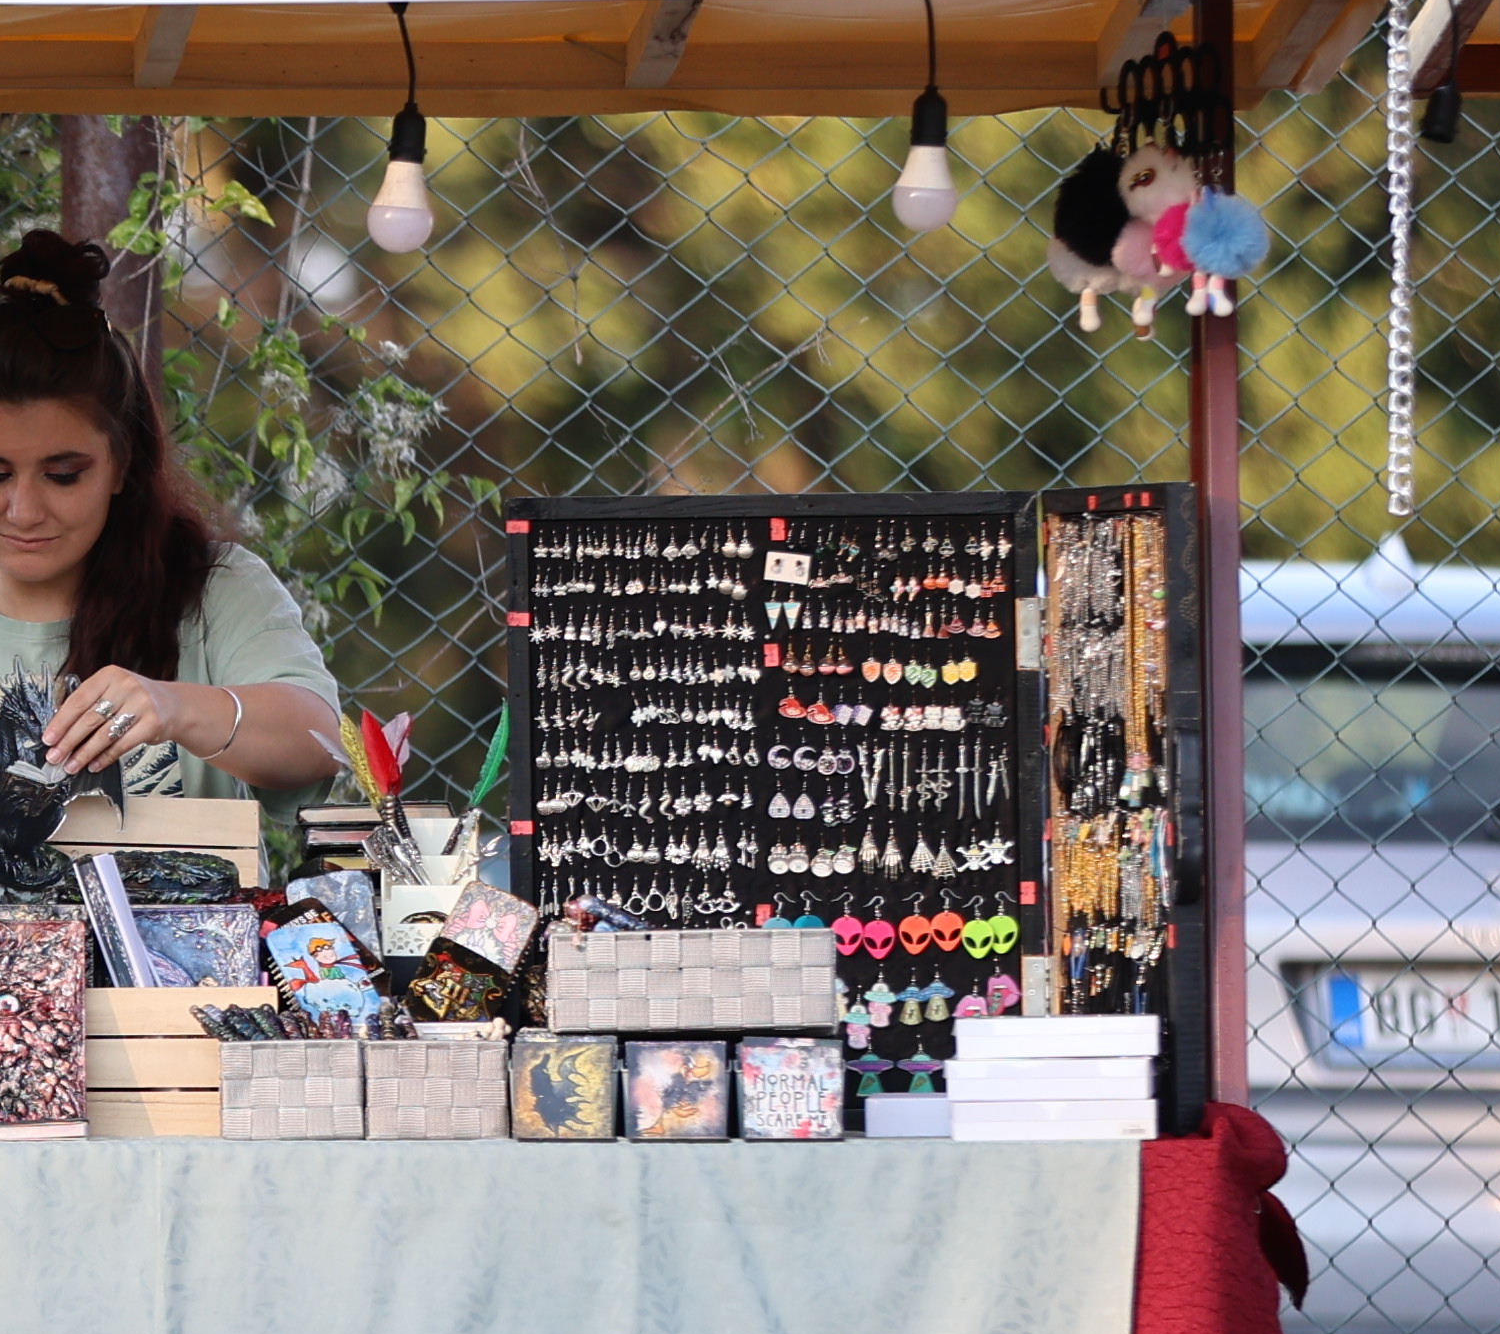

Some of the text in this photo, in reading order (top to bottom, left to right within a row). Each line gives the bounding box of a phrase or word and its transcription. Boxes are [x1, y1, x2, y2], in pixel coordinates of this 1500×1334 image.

[753, 1072, 830, 1092] NORMAL
[752, 1090, 828, 1114] PEOPLE
[756, 1113, 803, 1128] SCARE
